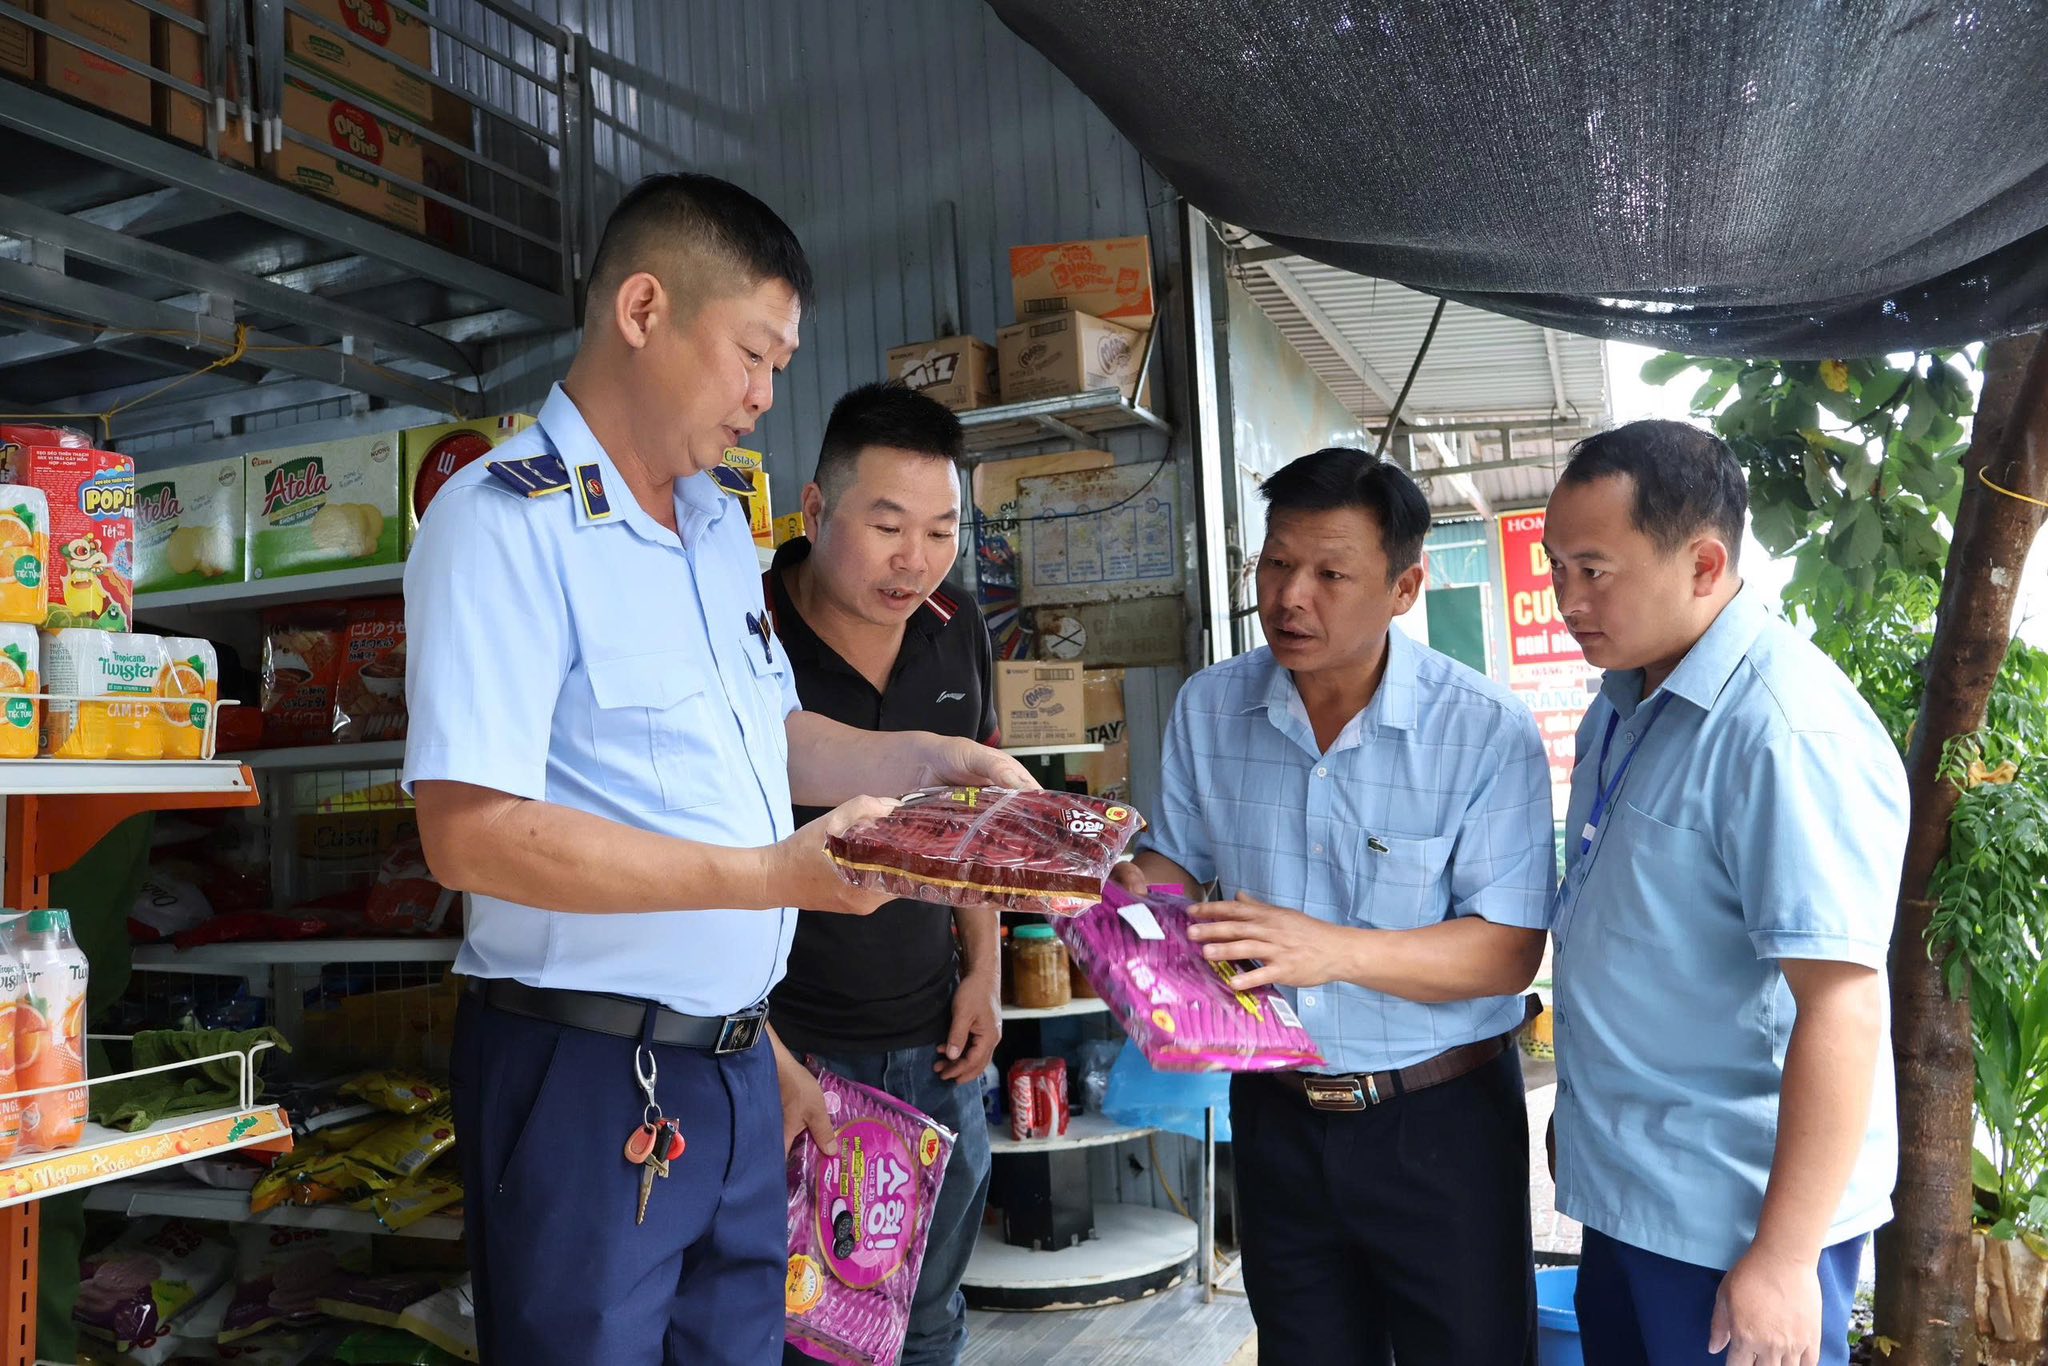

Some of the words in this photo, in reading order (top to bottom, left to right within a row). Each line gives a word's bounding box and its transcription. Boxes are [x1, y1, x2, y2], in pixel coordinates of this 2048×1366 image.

[358, 13, 388, 35] One
[334, 114, 365, 141] One
[349, 135, 379, 158] One
[437, 451, 456, 475] LU
[724, 450, 755, 466] Custas
[261, 462, 332, 517] Atela
[112, 650, 146, 663] Tropicana
[98, 656, 158, 682] Twister
[107, 703, 131, 718] CAM
[1087, 720, 1125, 743] TAY
[867, 1157, 910, 1250] 소형!
